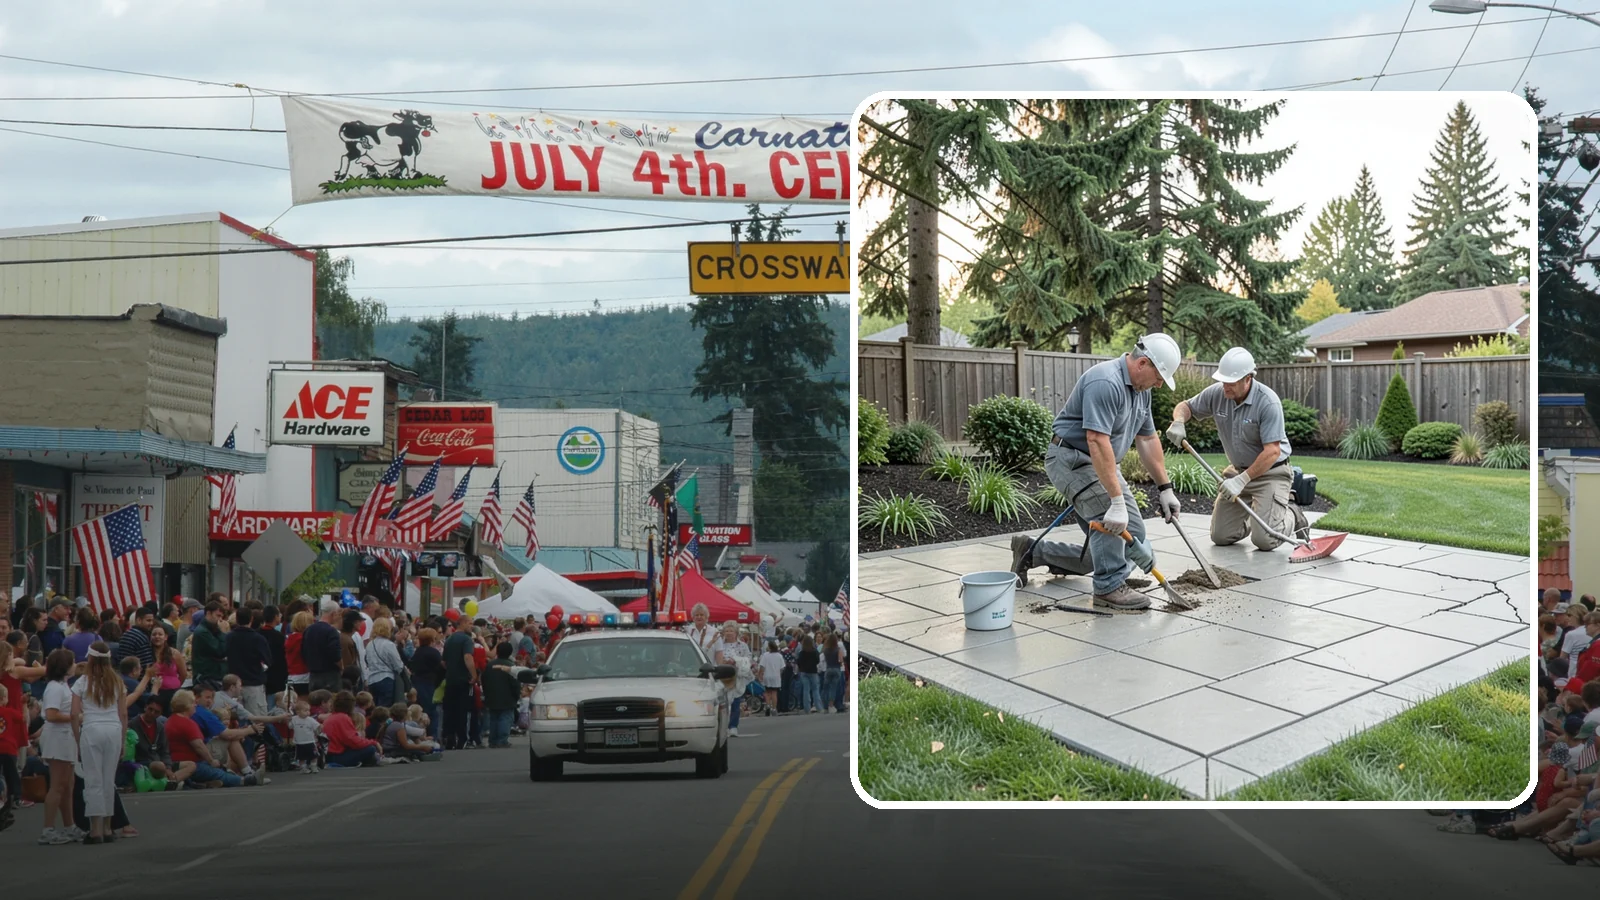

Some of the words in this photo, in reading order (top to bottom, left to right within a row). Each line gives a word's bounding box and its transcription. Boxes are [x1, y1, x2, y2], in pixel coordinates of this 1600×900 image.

[695, 121, 850, 150] Carnat
[481, 141, 605, 192] JULY
[632, 150, 746, 198] 4th.
[697, 254, 850, 280] CROSSWA
[283, 380, 374, 420] ACE
[406, 409, 452, 421] CEDAR
[283, 421, 371, 436] Hardware
[353, 467, 385, 481] Simpl
[96, 485, 124, 495] Vincent
[126, 486, 136, 495] de
[138, 486, 155, 496] Paul
[212, 516, 331, 535] HARDARE
[688, 526, 742, 535] CRNATION
[699, 535, 730, 543] GLASS
